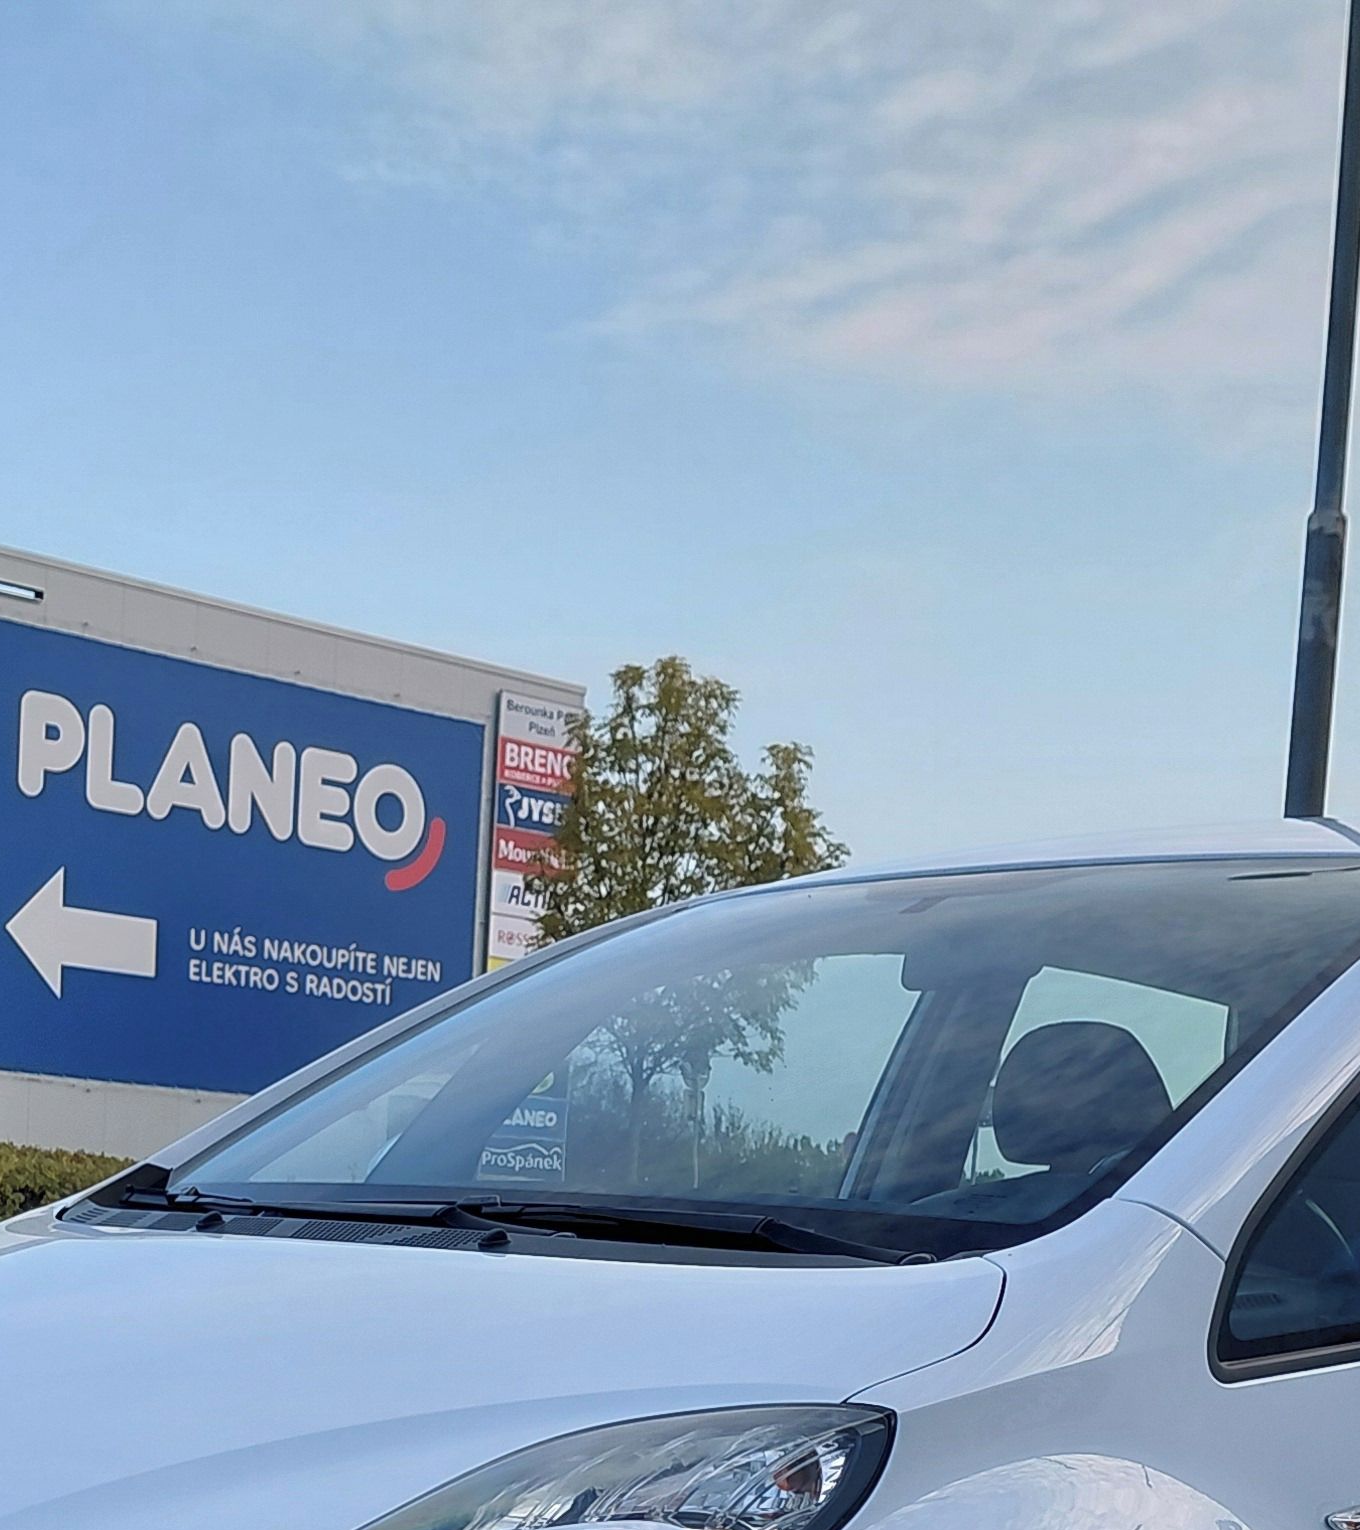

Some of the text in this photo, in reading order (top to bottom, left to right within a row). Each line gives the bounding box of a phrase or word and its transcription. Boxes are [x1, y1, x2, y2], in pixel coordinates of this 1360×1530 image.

[18, 690, 426, 861] PLANEO
[189, 927, 442, 983] U NÁS NAKOUPÍTE NEJEN
[188, 960, 393, 1006] ELEKTRO S RADOSTÍ
[481, 1150, 562, 1173] ProSpánek
